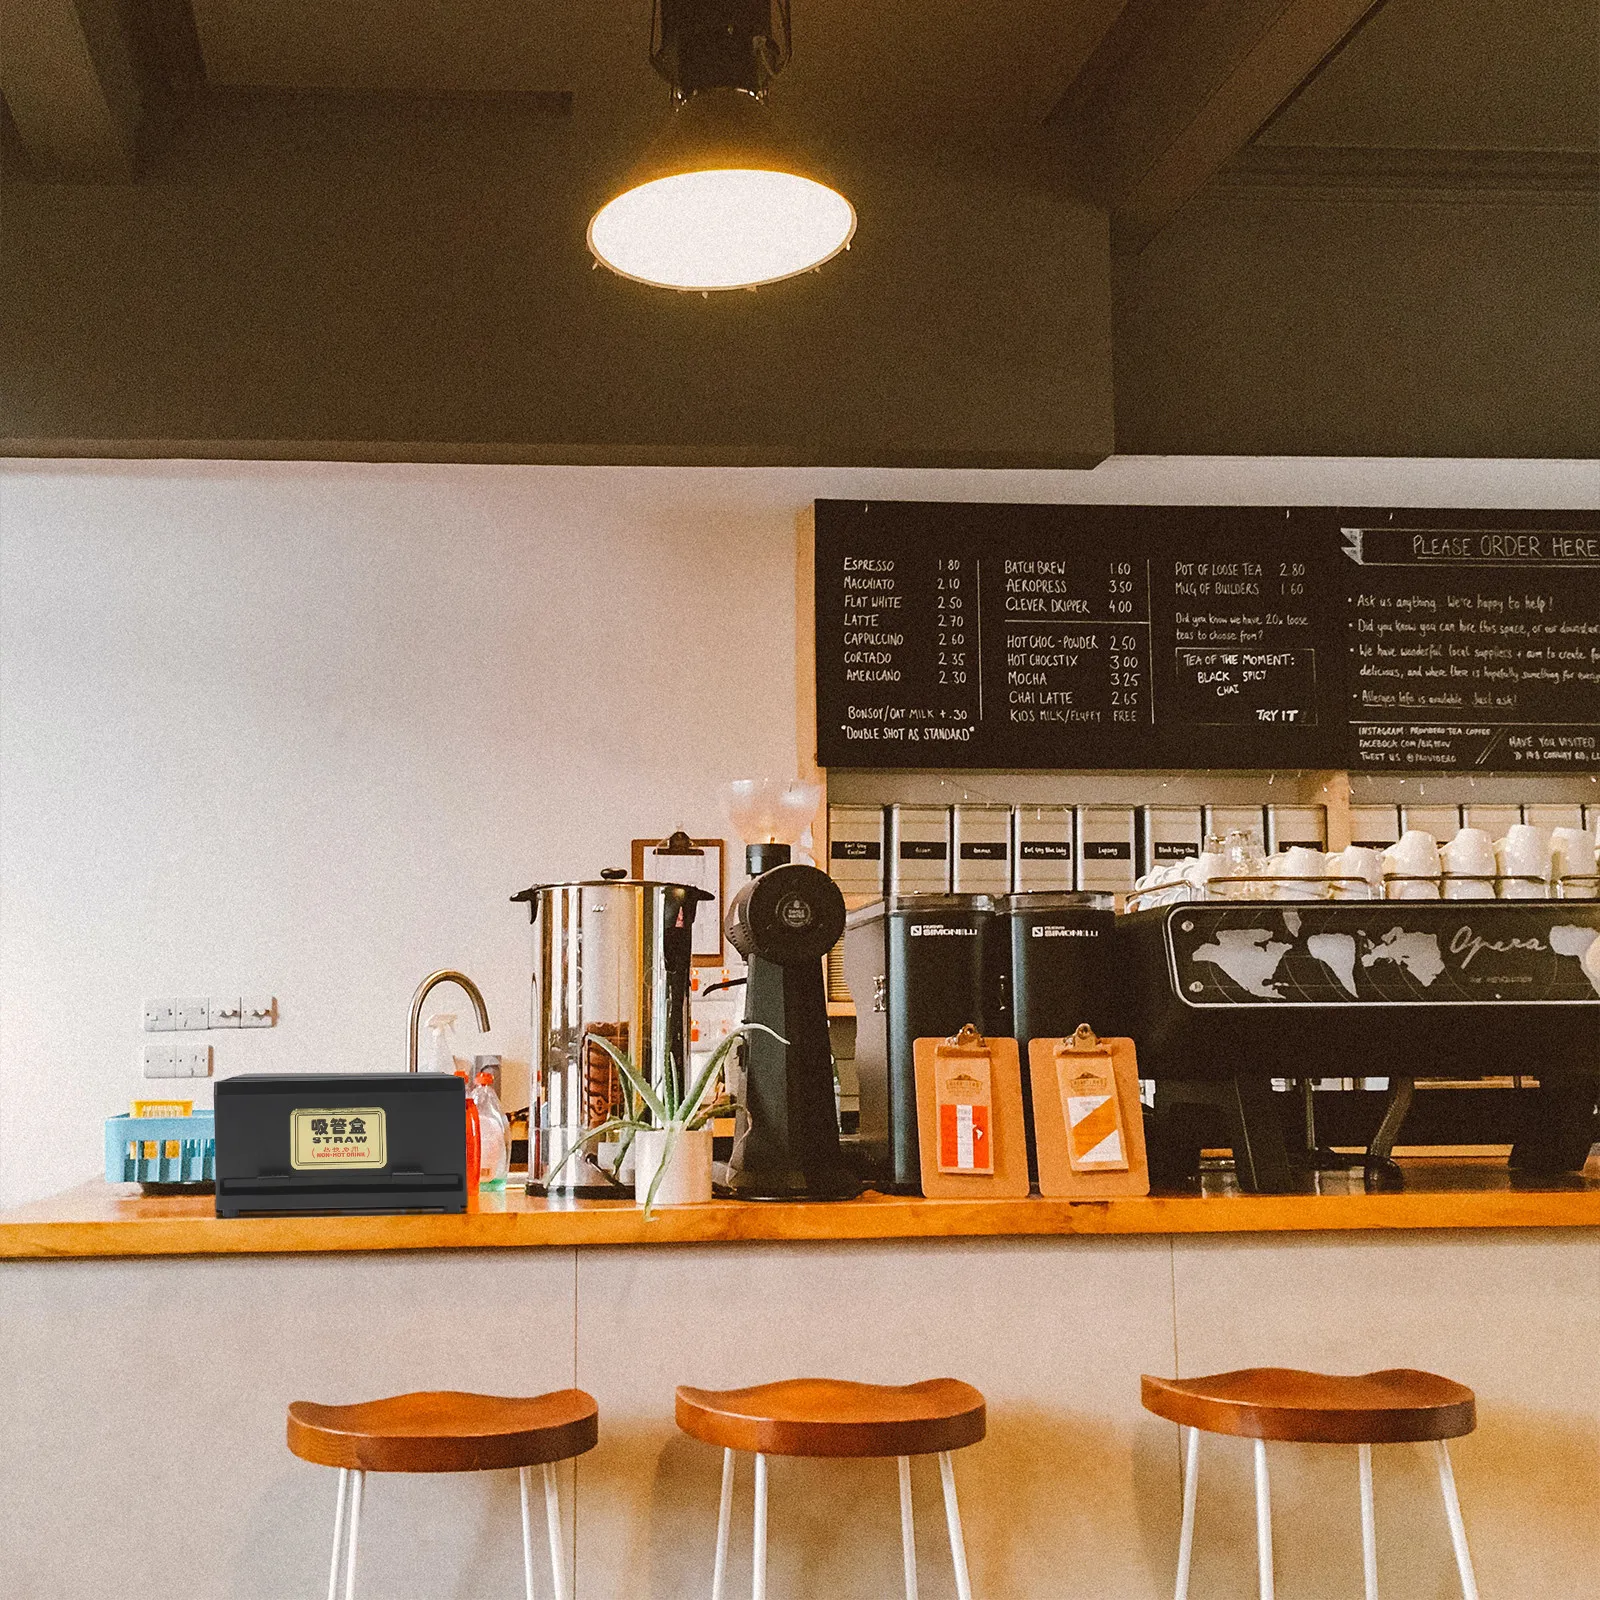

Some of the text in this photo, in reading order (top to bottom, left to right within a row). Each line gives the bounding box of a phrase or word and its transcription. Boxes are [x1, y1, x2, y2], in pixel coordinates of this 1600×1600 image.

[1413, 534, 1600, 557] PLEASE ORDER HERE
[843, 557, 895, 571] ESPRESSO
[1004, 560, 1066, 575] BATCH BREW
[1175, 561, 1263, 576] POT OF LOOSE TEA
[843, 575, 895, 590] MACCHIATO
[1005, 579, 1067, 593] AEROPRESS
[1175, 582, 1259, 597] MUG OF BUILDERS
[844, 595, 903, 608] FLAT WHITE
[1005, 596, 1090, 613] CLEVER DRIPPER
[1357, 594, 1376, 607] Ask
[1380, 597, 1392, 607] us
[1508, 595, 1520, 609] to
[844, 613, 879, 626] LATTE
[1175, 612, 1190, 624] Did
[1192, 616, 1207, 627] you
[1209, 613, 1227, 624] know
[1242, 613, 1262, 625] have
[1286, 614, 1309, 625] loose
[1176, 628, 1194, 640] teas
[1197, 630, 1207, 640] to
[1209, 630, 1237, 640] choose
[1358, 618, 1374, 632] Did
[1377, 624, 1393, 638] you
[1419, 623, 1437, 637] you
[1439, 623, 1456, 632] can
[843, 632, 904, 646] CAPPUCCINO
[1007, 635, 1028, 648] HOT
[1029, 635, 1055, 648] CHOC
[844, 651, 892, 664] CORTADO
[1360, 644, 1373, 656] We
[1377, 644, 1397, 657] have
[1546, 646, 1556, 659] to
[1007, 653, 1079, 667] HOT CHOCSTIX
[1183, 653, 1295, 666] TEA OF THE MOMENT:
[846, 669, 901, 682] AMERICANO
[1197, 670, 1267, 683] BLACK SPICY
[1407, 665, 1422, 677] and
[1007, 671, 1047, 686] MOCHA
[1216, 684, 1239, 696] CHAI
[1009, 690, 1073, 705] CHAI LATTE
[847, 704, 906, 722] BONSOY/OAT
[908, 709, 935, 720] MILK
[1010, 709, 1035, 723] KIDS
[1113, 710, 1137, 722] FREE
[1255, 709, 1299, 721] TRY IT
[883, 727, 906, 741] SHOT
[908, 728, 920, 741] AS
[1508, 736, 1533, 748] HAVE
[1538, 735, 1556, 748] YOU
[1450, 926, 1547, 969] Opera
[311, 1117, 366, 1135] 吸管盒
[312, 1136, 368, 1144] STRAW
